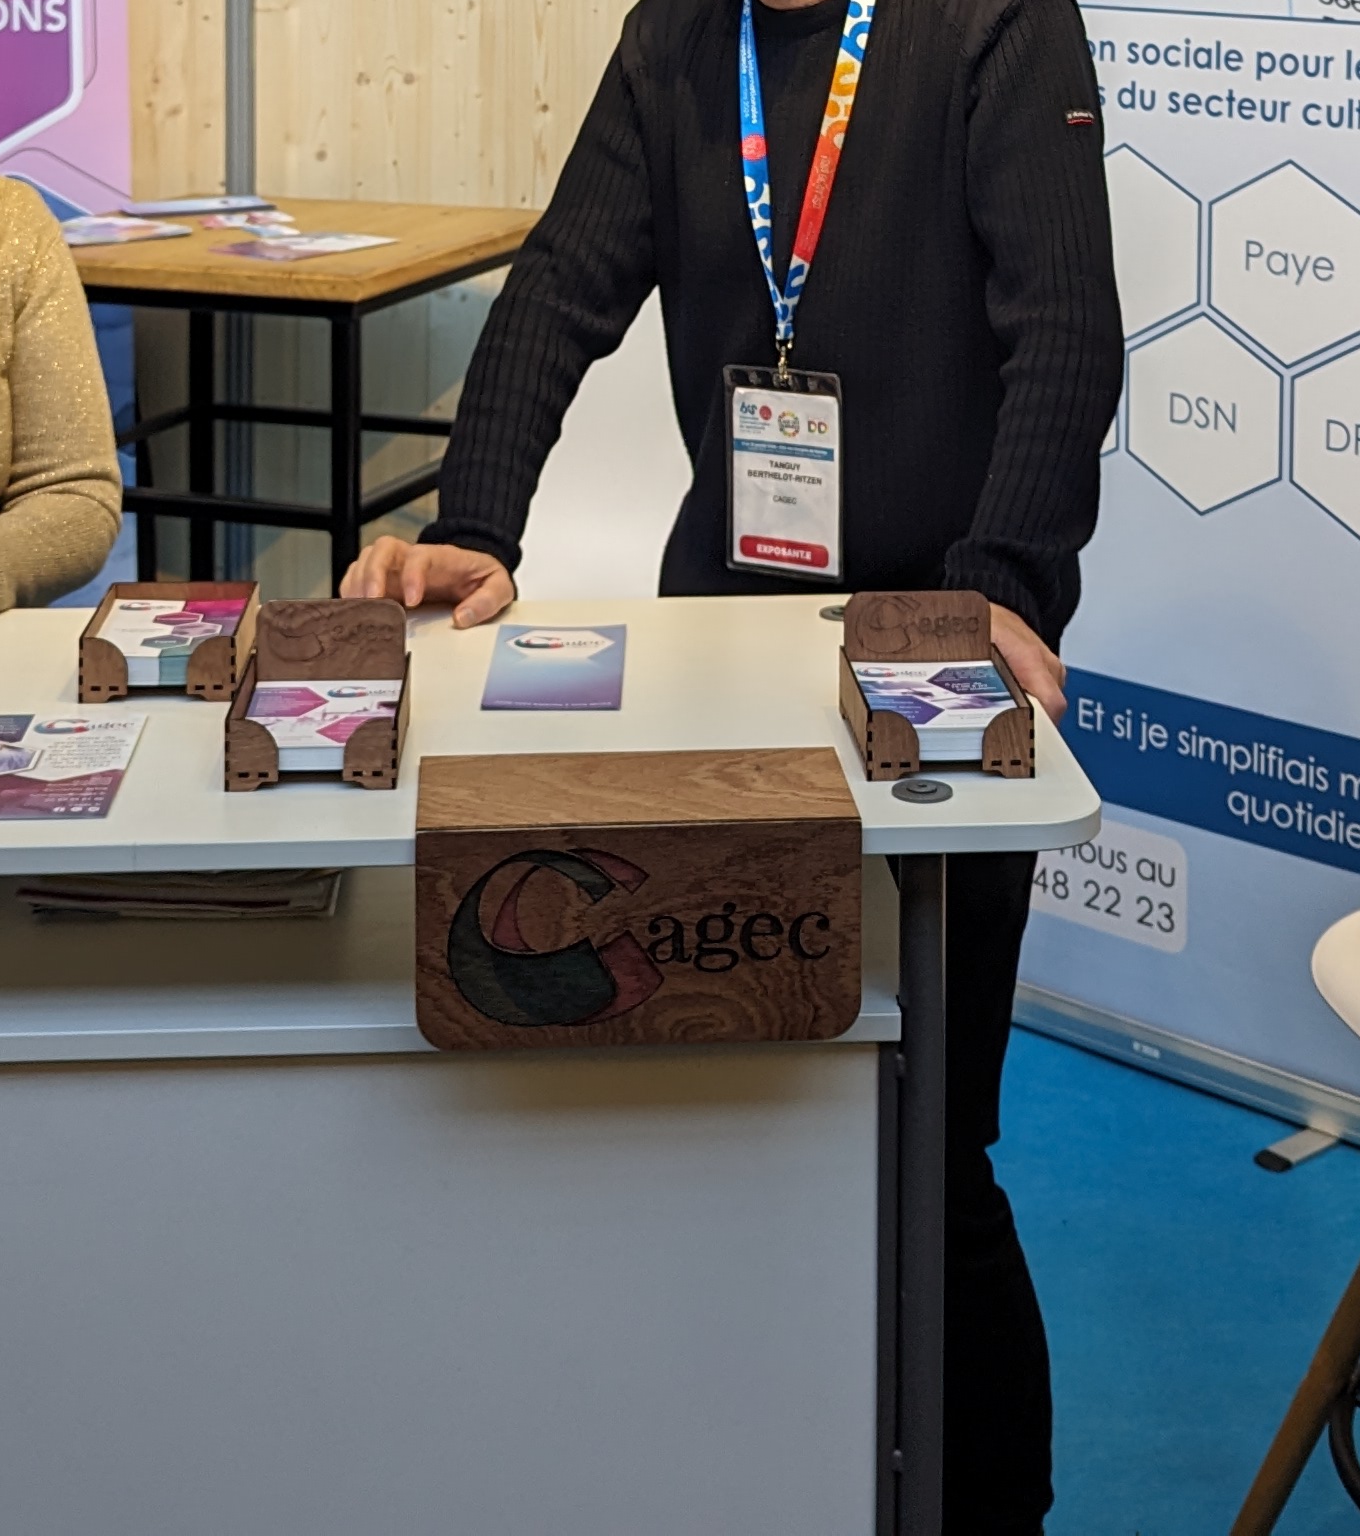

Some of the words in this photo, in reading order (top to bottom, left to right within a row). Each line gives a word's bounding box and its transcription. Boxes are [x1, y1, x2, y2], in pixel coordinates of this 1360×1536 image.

[1126, 37, 1242, 72] sociale
[1254, 51, 1335, 80] pour
[1116, 81, 1157, 112] du
[1166, 89, 1291, 125] secteur
[1245, 240, 1336, 286] Paye
[1170, 392, 1237, 433] DSN
[1078, 697, 1105, 732] Et
[1113, 710, 1133, 741] si
[1138, 712, 1169, 752] je
[1178, 726, 1329, 792] simplifiais
[1136, 855, 1176, 888] au
[1083, 880, 1121, 919] 22
[1136, 896, 1176, 934] 23
